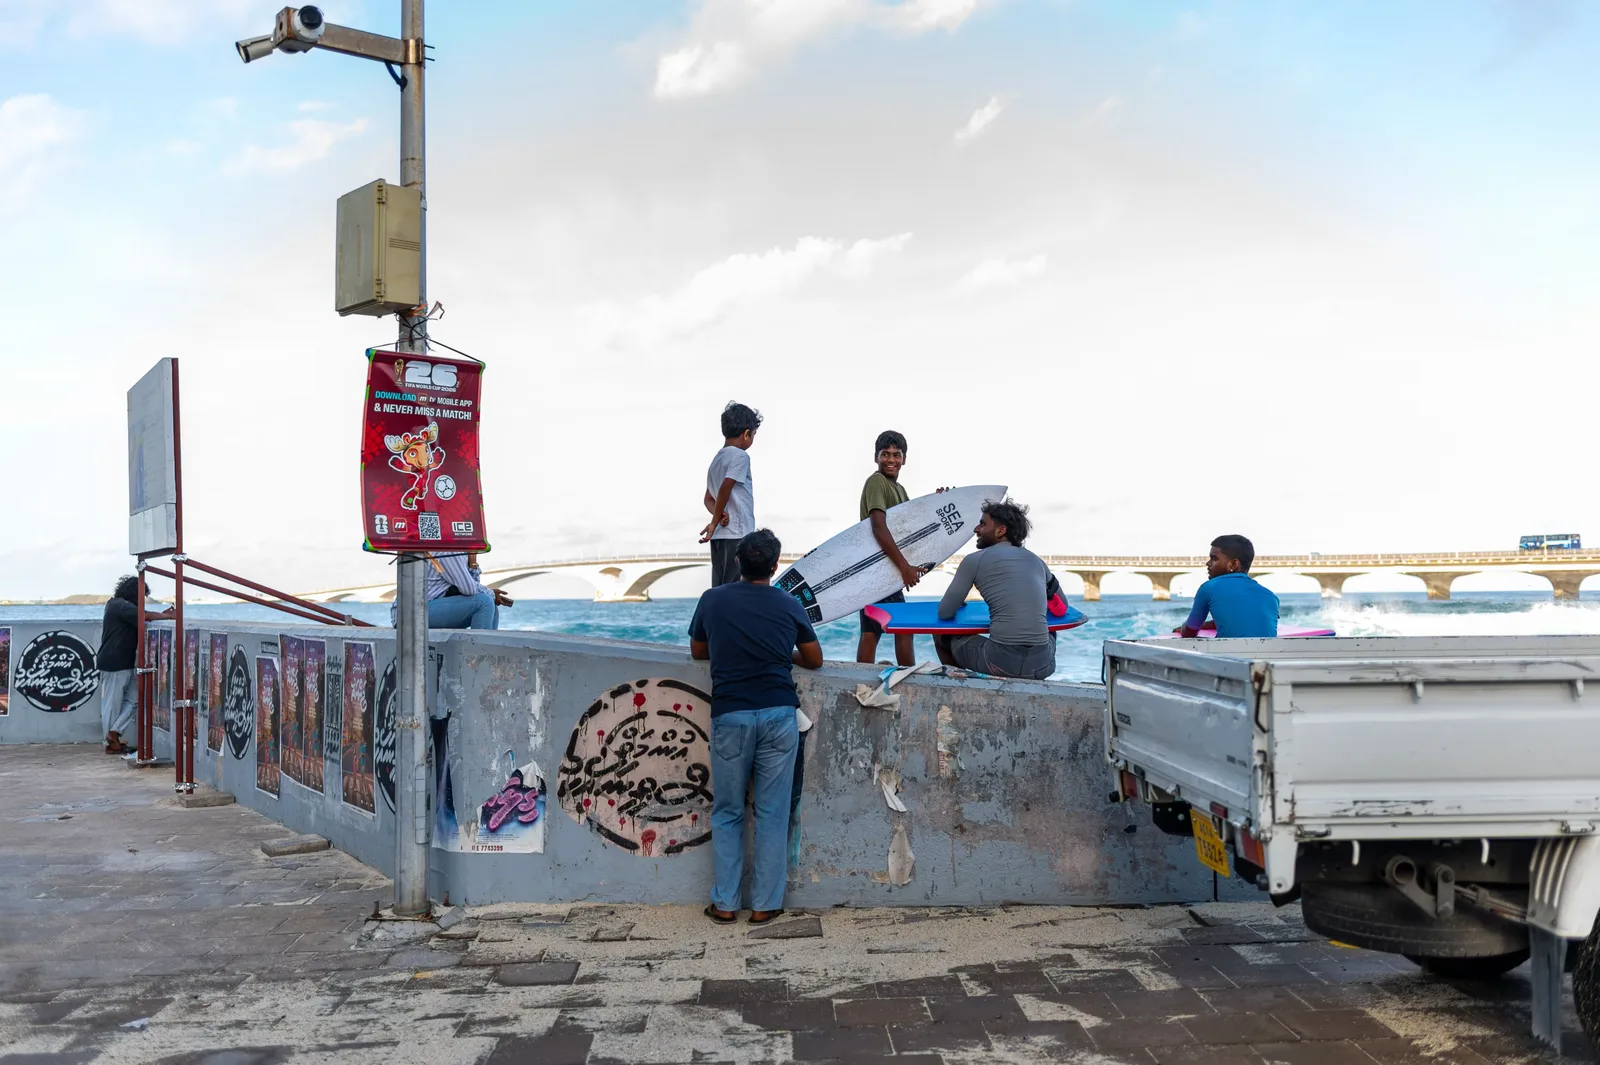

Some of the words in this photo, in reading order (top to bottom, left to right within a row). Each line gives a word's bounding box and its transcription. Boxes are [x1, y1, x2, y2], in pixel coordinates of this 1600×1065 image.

[405, 360, 458, 388] 26
[374, 402, 381, 412] &
[383, 403, 413, 415] NEVER
[414, 406, 435, 417] MISS
[435, 408, 442, 417] A
[442, 409, 472, 420] MATCH!
[375, 391, 417, 402] DOWNLOAD
[437, 397, 459, 406] MOBILE
[459, 400, 473, 408] APP
[935, 508, 955, 536] SPORTS
[943, 502, 965, 532] SEA
